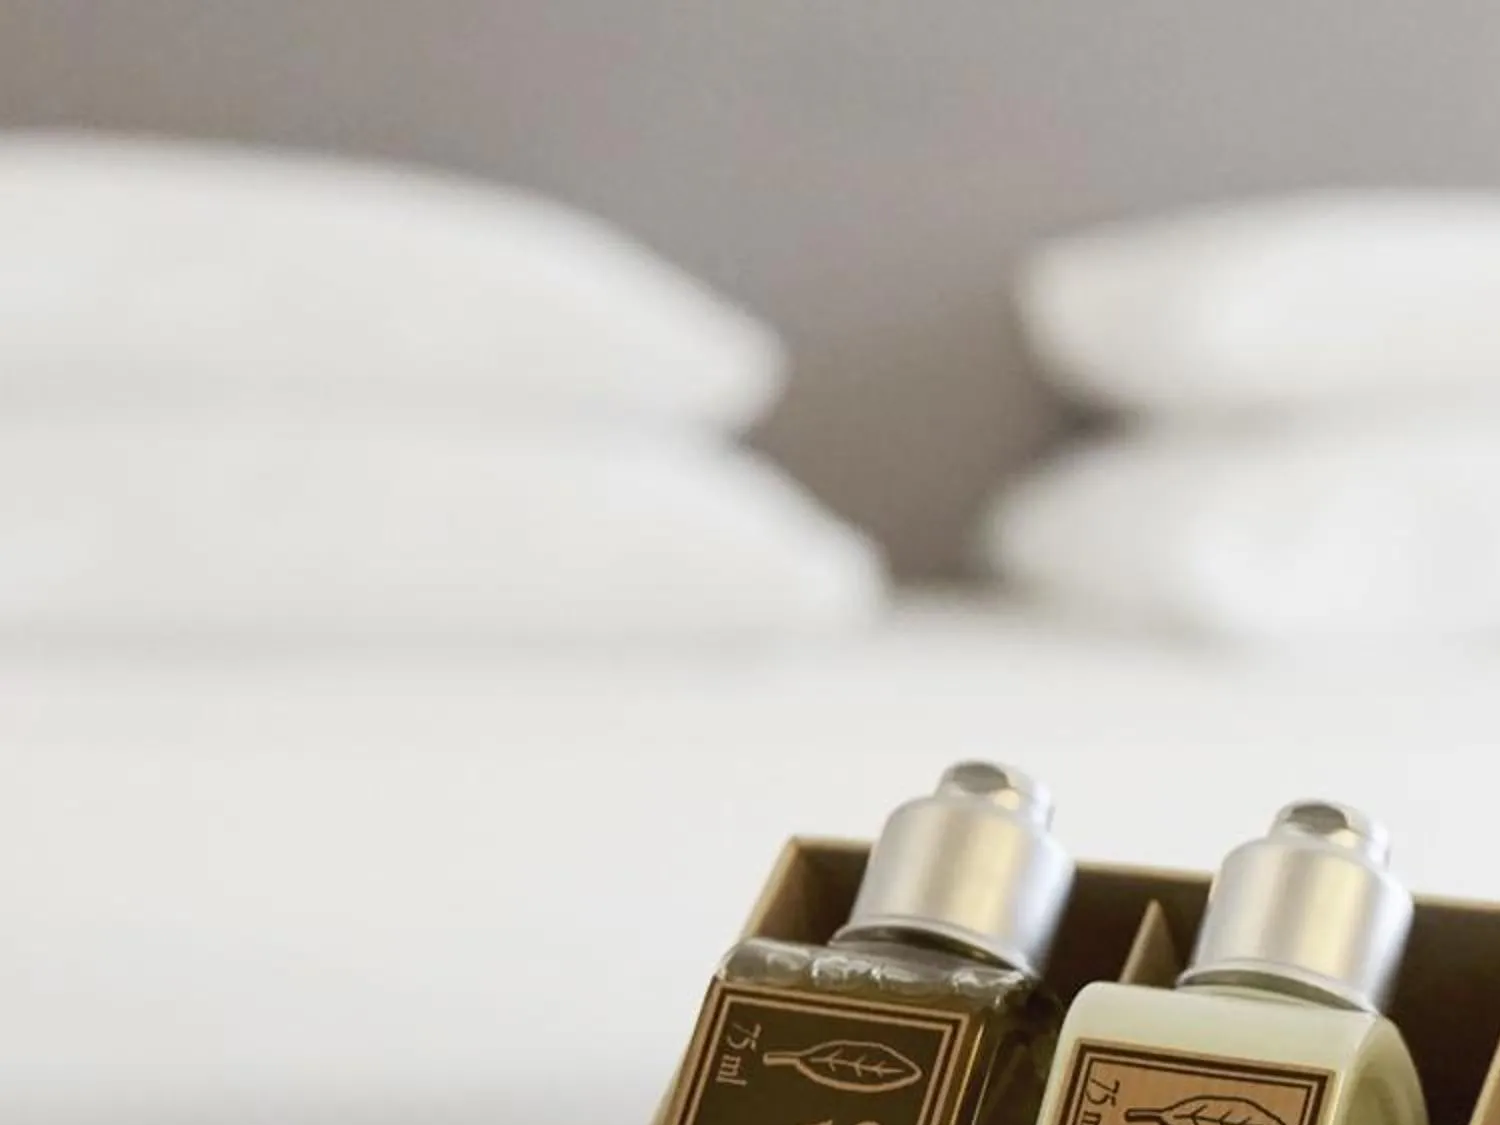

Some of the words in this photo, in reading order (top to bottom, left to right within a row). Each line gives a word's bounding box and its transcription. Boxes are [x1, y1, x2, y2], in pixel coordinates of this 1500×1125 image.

[725, 1022, 761, 1051] 75
[715, 1055, 748, 1087] ml
[1084, 1077, 1120, 1108] 75
